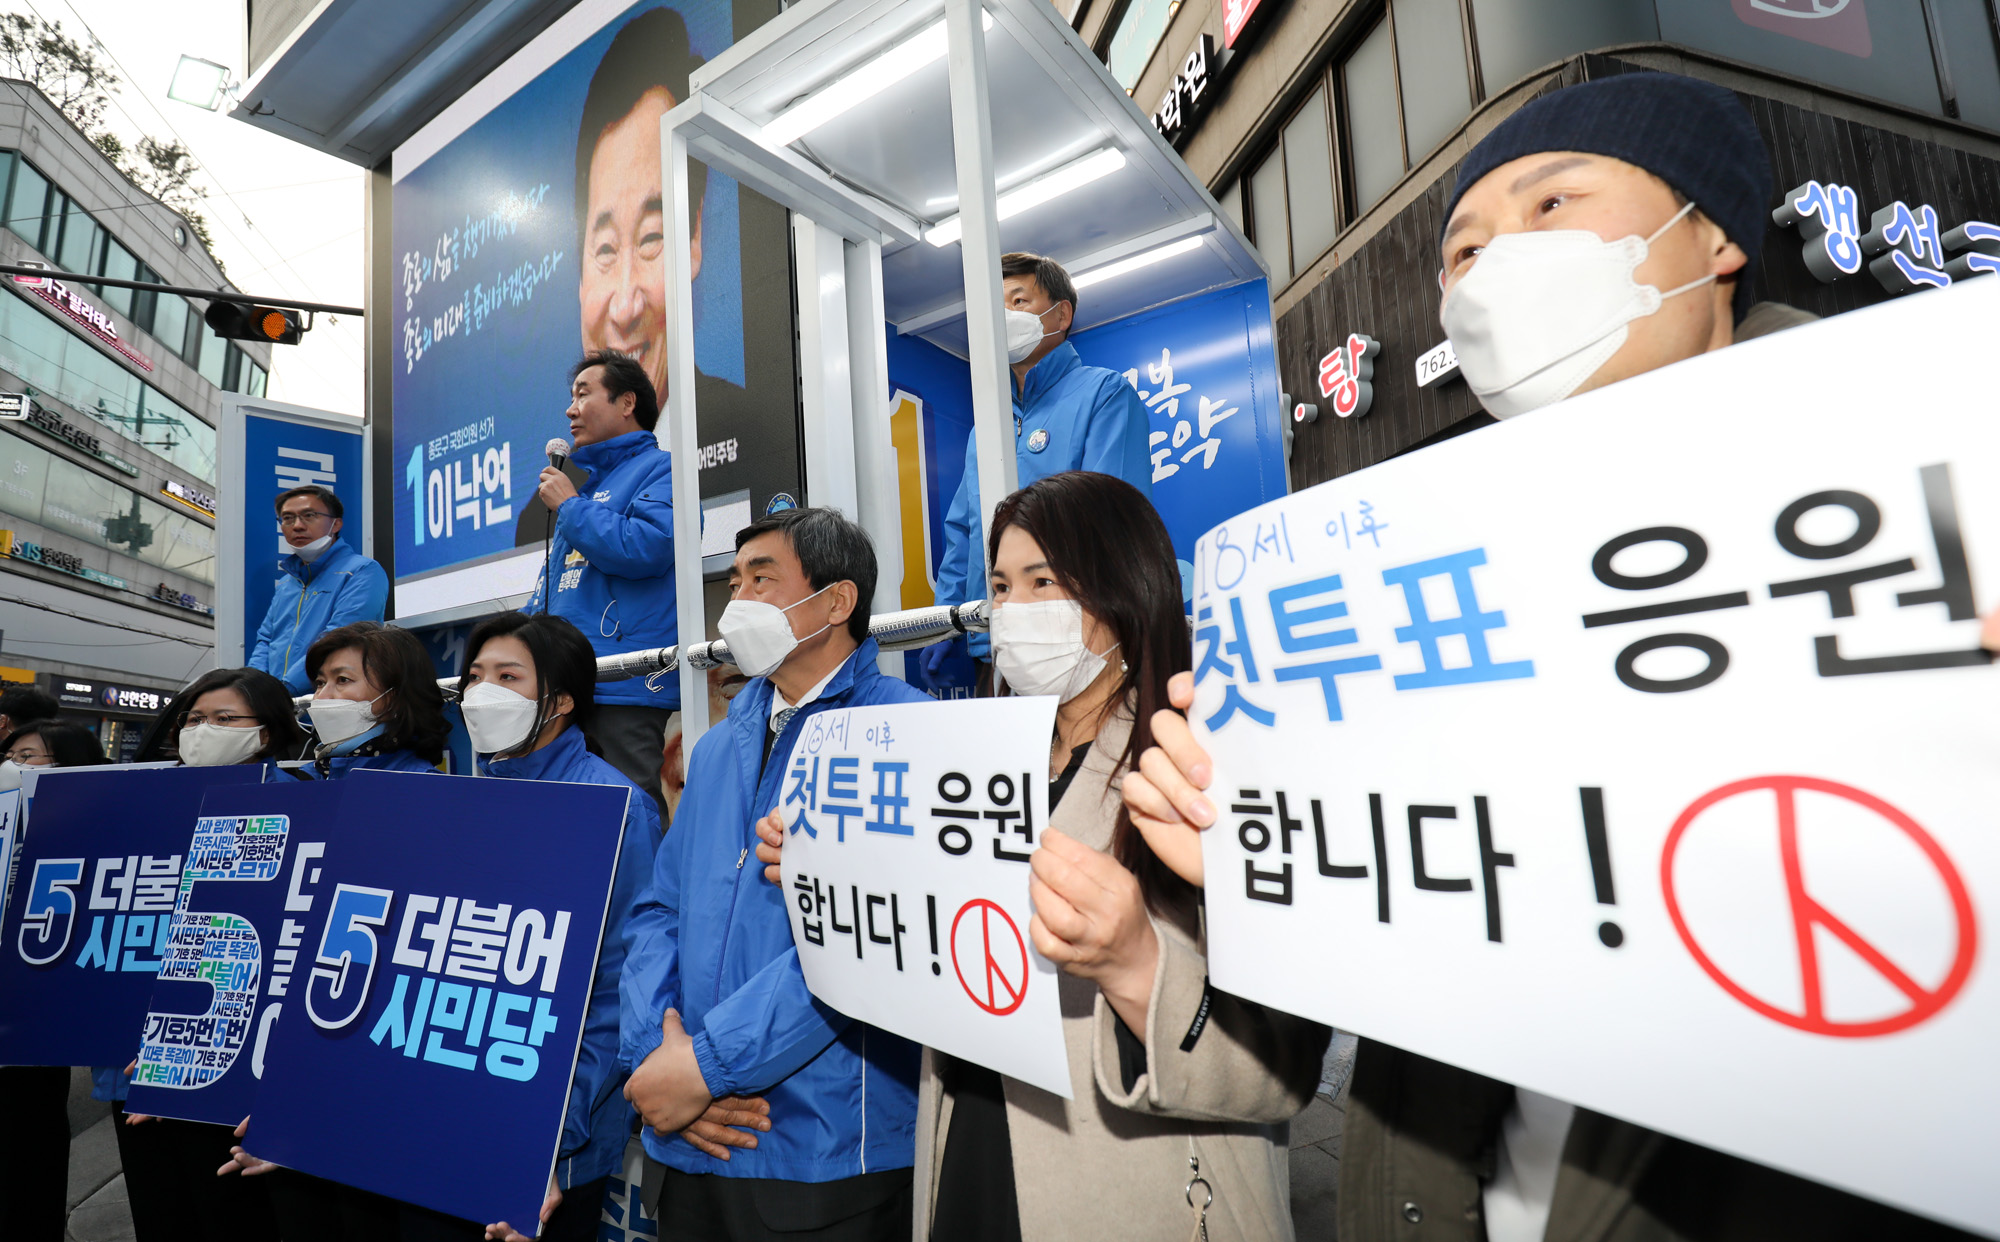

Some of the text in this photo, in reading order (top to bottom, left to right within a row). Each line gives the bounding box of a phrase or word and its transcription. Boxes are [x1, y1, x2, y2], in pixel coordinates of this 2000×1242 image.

[1151, 33, 1206, 133] 학원
[69, 291, 117, 340] 필라테스
[403, 251, 431, 313] 종로의
[433, 233, 459, 282] 삶을
[403, 250, 563, 375] 종로의 미래를 준비하겠습니다
[1318, 333, 1367, 418] 탕
[1421, 350, 1457, 378] 762.
[428, 416, 494, 462] 종로구 국회의원 선거
[406, 443, 425, 546] 1
[428, 441, 512, 539] 이낙연
[1192, 462, 1998, 734] 첫투표 응원
[1199, 500, 1389, 600] 18세 이후
[118, 690, 159, 710] 신한은행
[801, 712, 895, 755] 18세 이후
[785, 756, 1033, 864] 첫투표 응원
[18, 857, 84, 965] 5
[1230, 788, 1516, 945] 합니다
[305, 883, 393, 1029] 5
[391, 894, 572, 993] 더불어
[794, 873, 907, 973] 합니다
[369, 974, 559, 1082] 시민당
